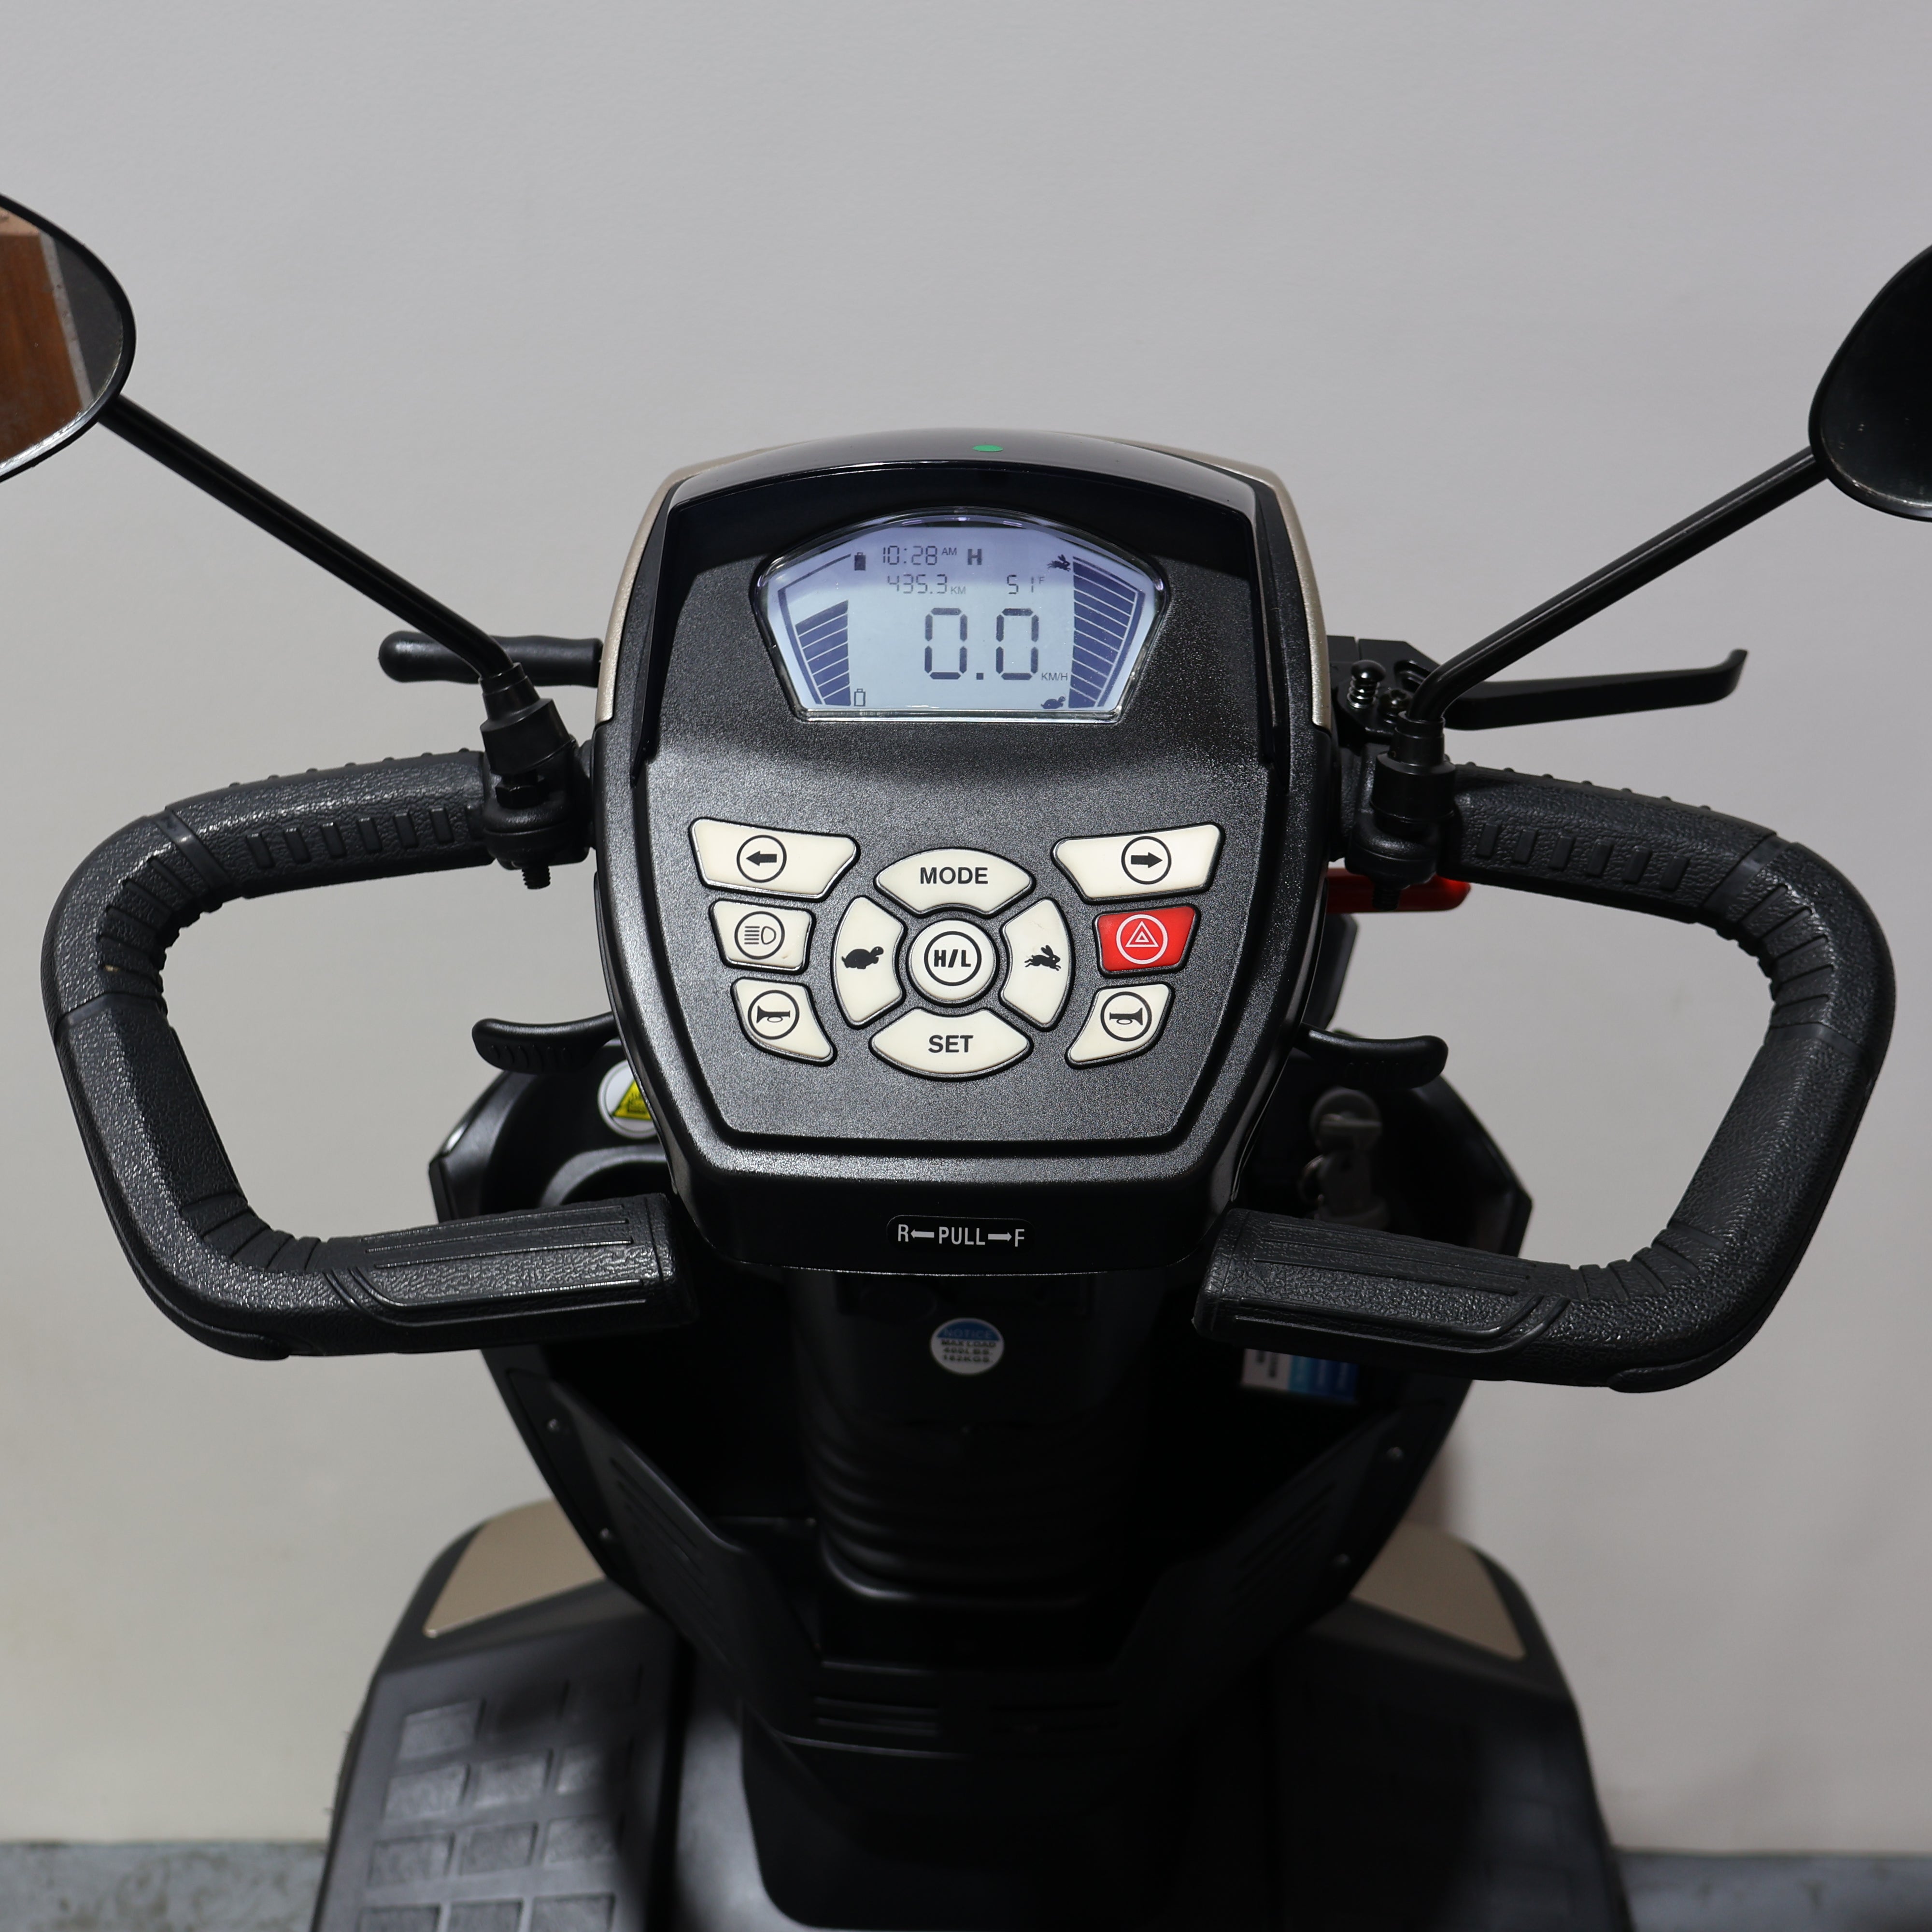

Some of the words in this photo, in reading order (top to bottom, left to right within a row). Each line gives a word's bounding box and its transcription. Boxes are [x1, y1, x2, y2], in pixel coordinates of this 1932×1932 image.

[882, 545, 938, 566] 10:28
[942, 547, 957, 555] AM
[967, 548, 982, 566] H
[887, 573, 947, 594] 435.3
[951, 586, 966, 595] KM
[924, 607, 1039, 681] 0.0
[1041, 672, 1068, 682] KM/H
[920, 867, 989, 885] MODE
[934, 949, 971, 968] H/L
[928, 1035, 974, 1053] SET
[898, 1224, 909, 1242] R
[939, 1226, 986, 1245] PULL
[1015, 1229, 1025, 1247] F
[944, 1329, 993, 1338] NOTICE
